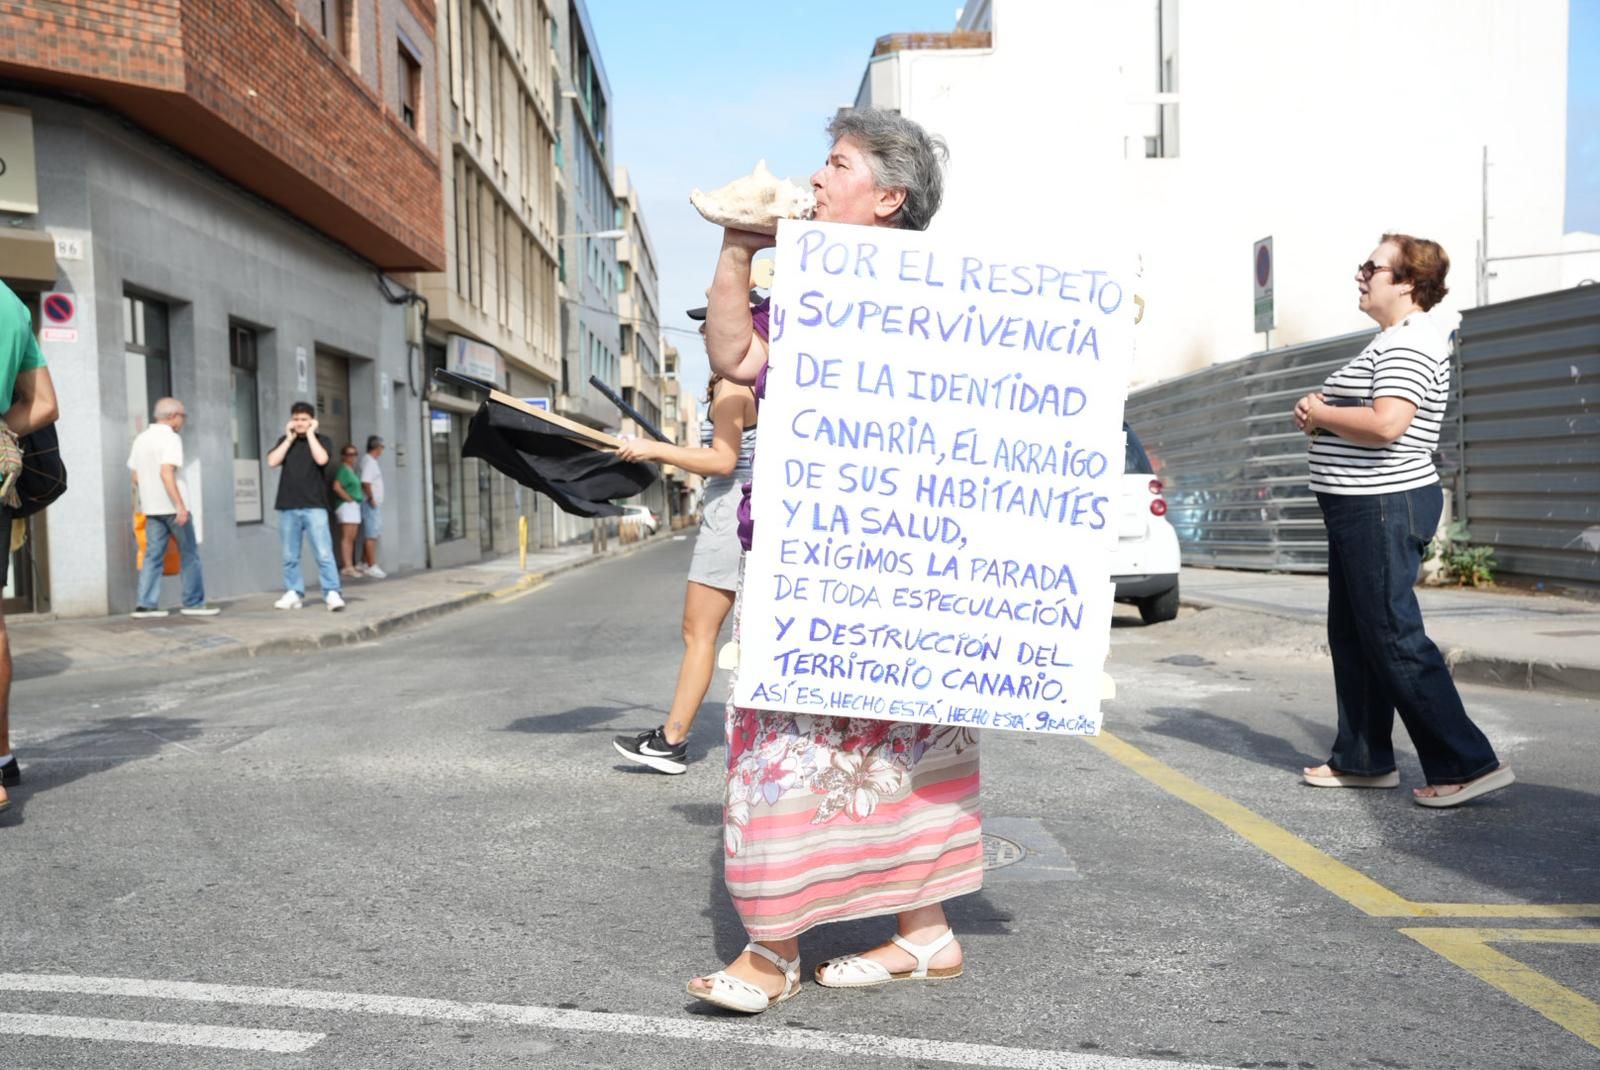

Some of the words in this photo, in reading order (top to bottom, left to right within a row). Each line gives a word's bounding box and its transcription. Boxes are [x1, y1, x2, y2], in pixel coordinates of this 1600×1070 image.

[58, 241, 77, 254] 86
[797, 229, 877, 280] POR
[898, 249, 944, 288] EL
[959, 256, 1123, 315] RESPETO
[795, 352, 843, 390] DE
[856, 360, 896, 398] LA
[950, 427, 988, 466] EL
[784, 458, 826, 490] DE
[838, 462, 900, 497] SUS
[782, 499, 803, 529] Y
[811, 501, 851, 536] LA
[860, 505, 968, 551] SALUD,
[773, 573, 809, 602] DE
[819, 577, 883, 609] TODA
[926, 551, 959, 581] LA
[970, 557, 1079, 597] PARADA
[774, 614, 796, 642] Y
[1016, 641, 1074, 668] DEL
[830, 690, 886, 715] HECHO
[946, 704, 989, 726] HECHO
